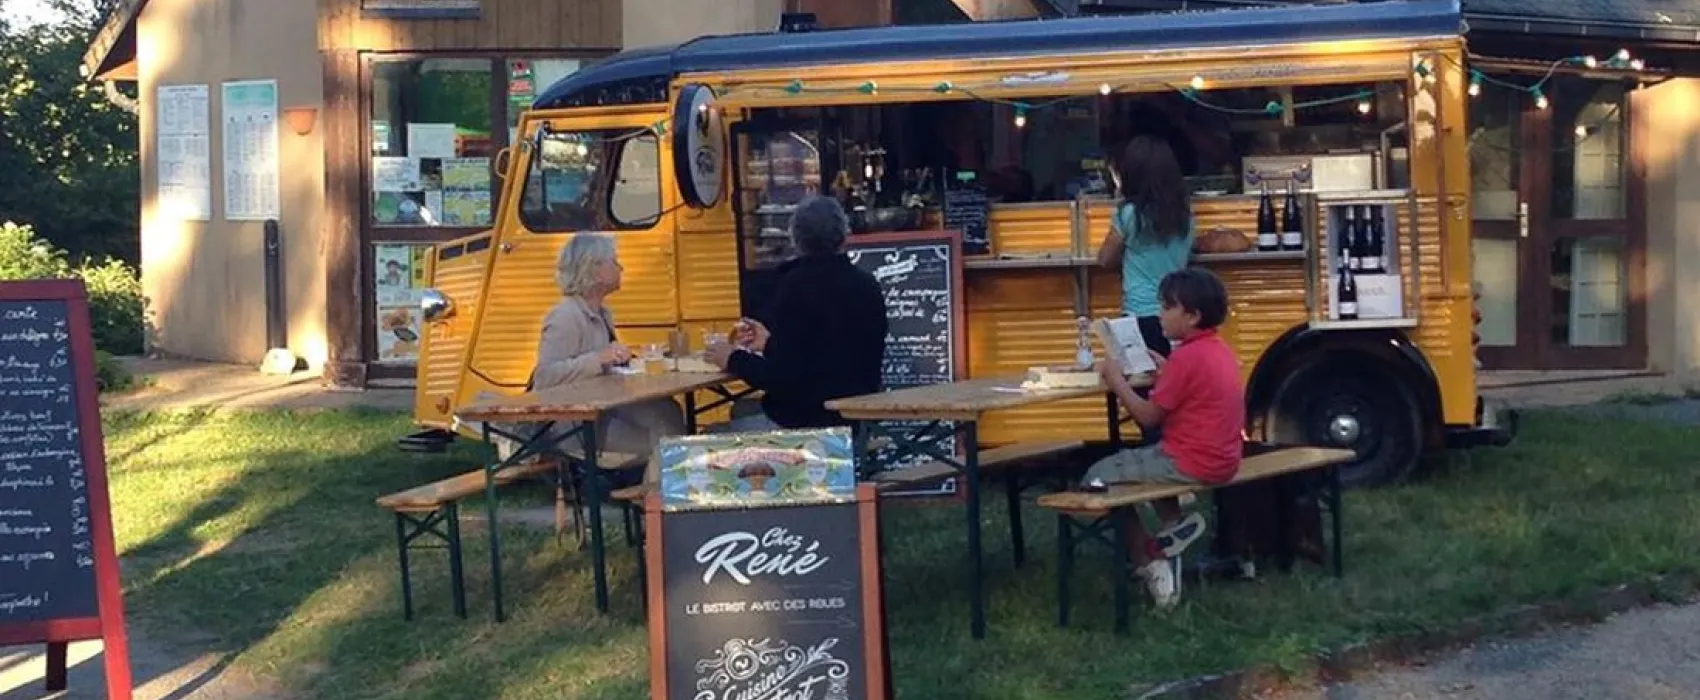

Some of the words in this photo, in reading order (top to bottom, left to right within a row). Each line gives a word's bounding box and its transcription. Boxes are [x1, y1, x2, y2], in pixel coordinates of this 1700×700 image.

[762, 527, 803, 552] Chez
[695, 531, 830, 585] René
[686, 603, 700, 615] LE
[702, 601, 747, 614] BISTROT
[750, 600, 781, 612] AVEC
[783, 599, 806, 611] DES
[809, 597, 846, 609] ROUES
